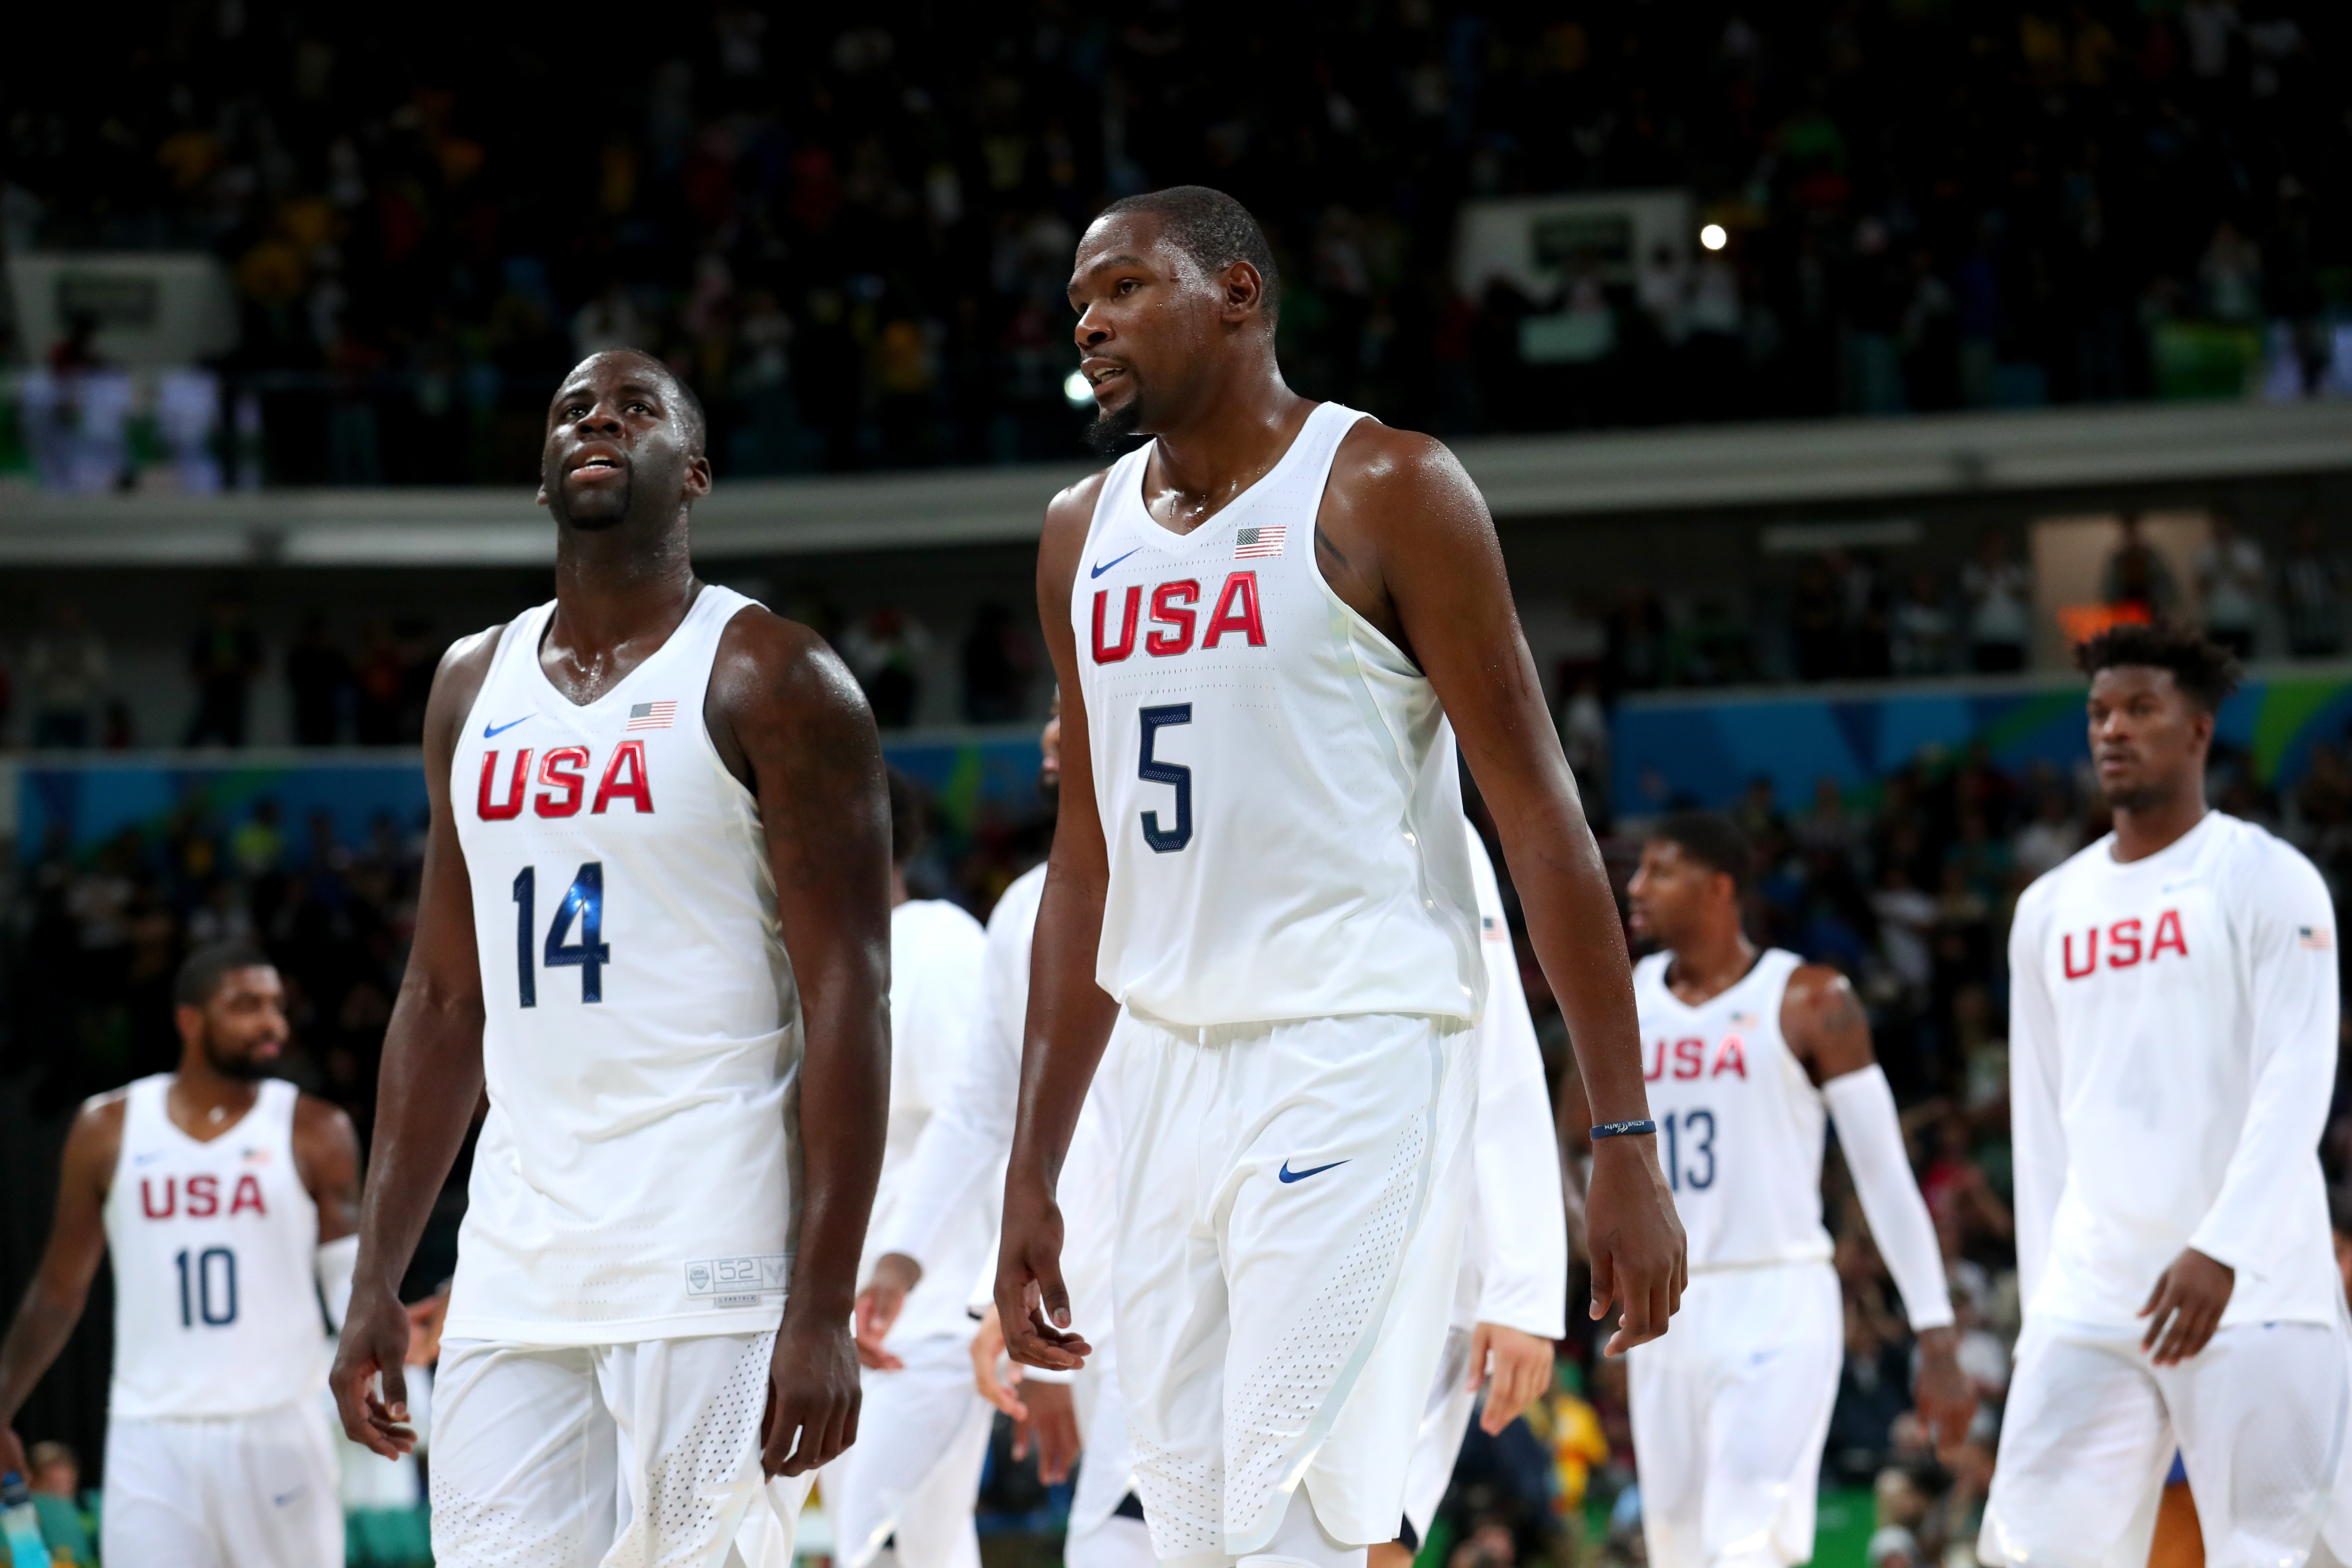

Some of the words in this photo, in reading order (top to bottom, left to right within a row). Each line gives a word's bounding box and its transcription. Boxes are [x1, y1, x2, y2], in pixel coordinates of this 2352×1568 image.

[1091, 570, 1267, 666] USA
[477, 740, 655, 821] USA
[1138, 702, 1193, 854] 5
[512, 861, 610, 1009] 14
[2063, 910, 2188, 979] USA
[1642, 1033, 1747, 1082] USA
[1663, 1108, 1716, 1192] 13
[142, 1175, 266, 1220] USA
[175, 1247, 237, 1327] 10
[719, 1260, 755, 1280] 52
